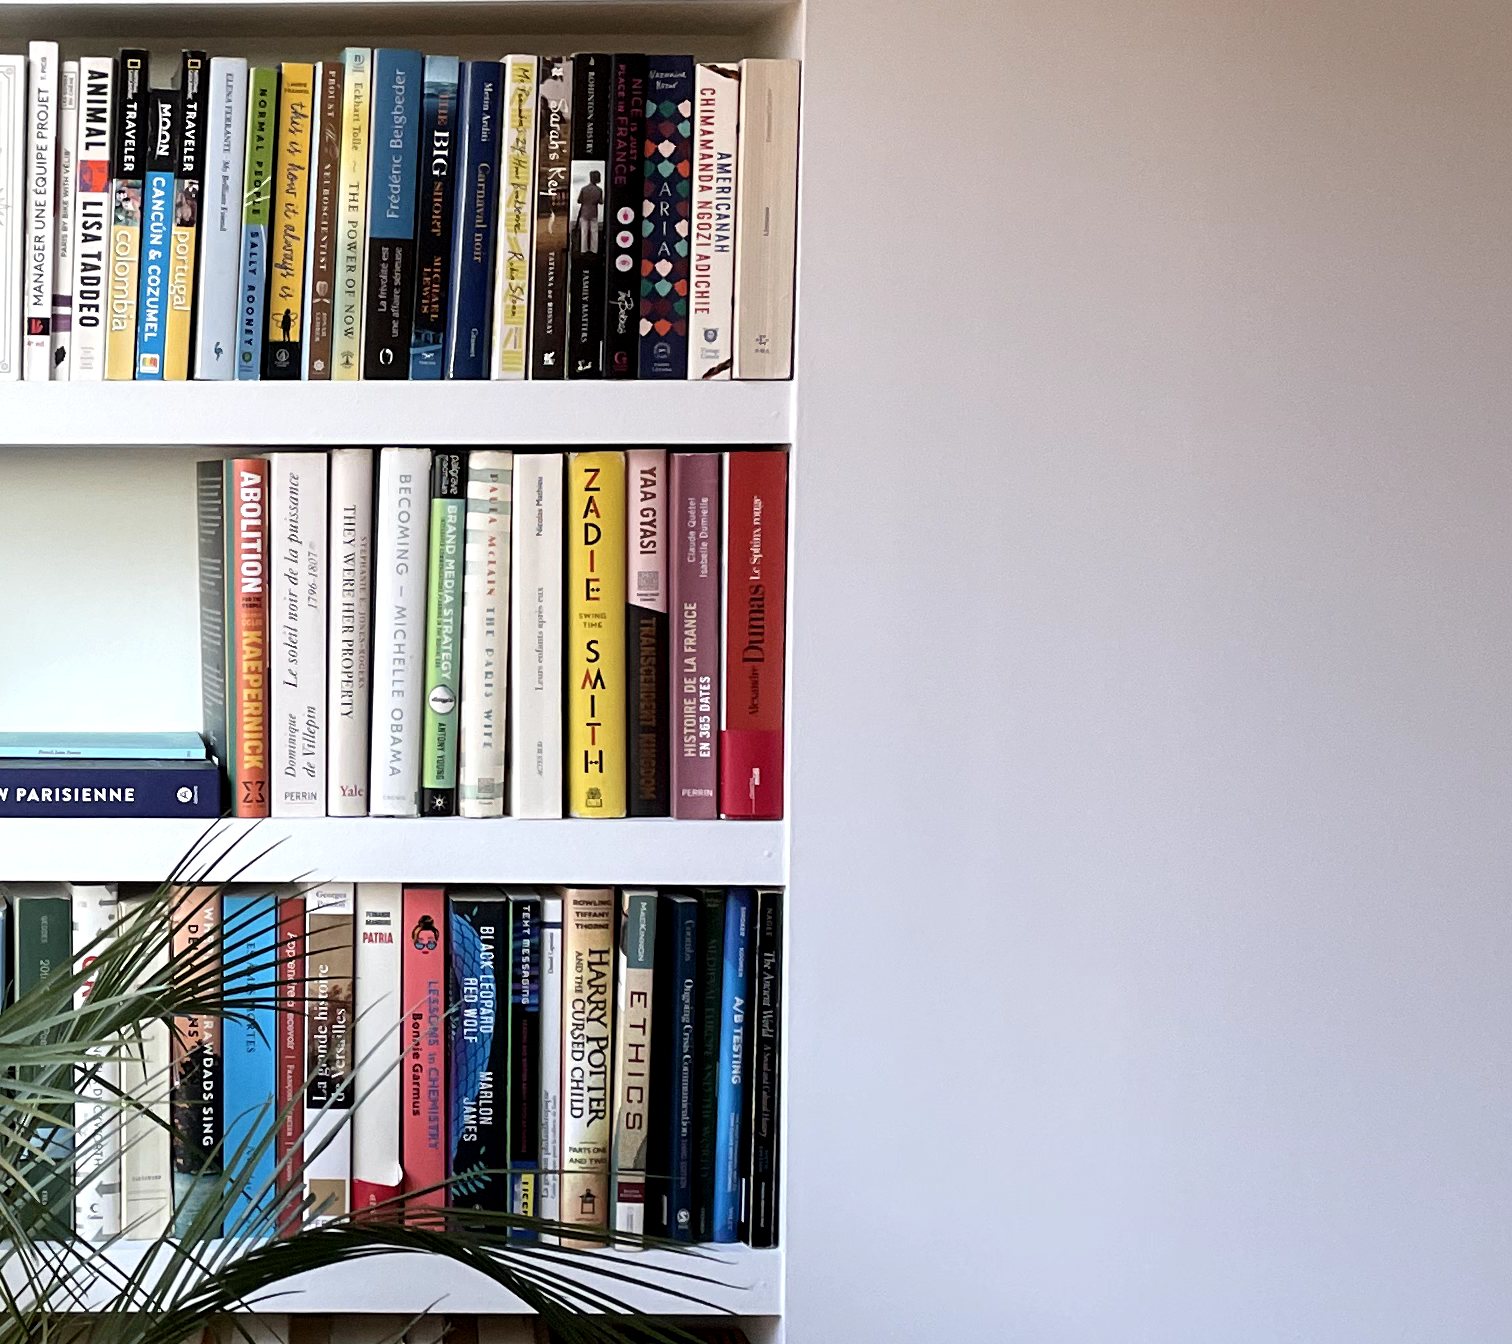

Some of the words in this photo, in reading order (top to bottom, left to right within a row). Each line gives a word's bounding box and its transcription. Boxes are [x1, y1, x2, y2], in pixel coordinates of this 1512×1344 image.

[36, 88, 49, 140] PROJET
[84, 68, 109, 150] ANIMAL
[352, 82, 364, 119] Eckhart
[388, 70, 406, 149] Beigbeder
[123, 102, 138, 172] TRAVELER
[157, 103, 172, 156] MOON
[183, 102, 198, 172] TRAVELER
[351, 122, 362, 150] Tolle
[431, 130, 450, 177] BIG
[548, 98, 565, 160] Sarah's
[697, 87, 716, 192] CHIMAMANDA
[32, 145, 48, 196] ÉQUIPE
[385, 156, 400, 218] Frédéric
[475, 162, 490, 228] Carnaval
[539, 167, 562, 196] Key
[33, 200, 46, 231] UNE
[82, 201, 103, 242] LISA
[150, 176, 170, 243] CANCÚN
[347, 181, 360, 213] THE
[715, 151, 733, 253] AMERICANAH
[345, 220, 359, 272] POWER
[473, 233, 486, 262] noir
[696, 200, 712, 247] NGOZI
[32, 235, 46, 306] MANAGER
[149, 248, 162, 260] &
[170, 231, 192, 310] portugal
[248, 231, 260, 275] SALLY
[78, 251, 102, 328] TADDEO
[111, 230, 133, 331] colombia
[144, 265, 161, 342] COZUMEL
[345, 278, 357, 298] OF
[694, 253, 711, 314] ADICHIE
[244, 284, 257, 346] ROONEY
[343, 304, 355, 338] NOW
[286, 472, 302, 545] puissance
[640, 466, 656, 502] YAA
[241, 471, 262, 592] ABOLITION
[343, 504, 356, 547] THEY
[396, 473, 412, 576] BECOMING
[445, 505, 457, 554] BRAND
[583, 468, 601, 601] ZADIE
[639, 507, 656, 555] GYASI
[285, 549, 299, 564] la
[285, 568, 299, 586] de
[342, 552, 355, 598] WERE
[444, 558, 455, 604] MEDIA
[284, 589, 299, 621] noir
[341, 602, 354, 634] HER
[684, 602, 697, 654] FRANCE
[742, 585, 765, 663] Dumas
[283, 627, 299, 664] soleil
[391, 605, 406, 698] MICHELLE
[441, 608, 454, 679] STRATEGY
[683, 656, 697, 672] LA
[243, 630, 264, 769] KAEPERNICK
[283, 668, 299, 688] Le
[340, 639, 354, 719] PROPERTY
[683, 676, 697, 694] DE
[699, 676, 711, 712] DATES
[581, 639, 606, 773] SMITH
[683, 696, 697, 757] HISTOIRE
[699, 715, 711, 739] 365
[388, 708, 405, 777] OBAMA
[699, 742, 711, 758] EN
[16, 787, 135, 802] PARISIENNE
[480, 926, 494, 968] BLACK
[428, 980, 440, 1046] LESSONS
[463, 977, 478, 1003] RED
[479, 974, 494, 1033] LEOPARD
[588, 948, 610, 1031] HARRY
[732, 996, 744, 1022] A/B
[411, 1012, 423, 1059] Bonnie
[463, 1008, 477, 1043] WOLF
[569, 998, 585, 1061] CURSED
[586, 1035, 608, 1128] POTTER
[626, 990, 648, 1131] ETHICS
[731, 1027, 743, 1084] TESTING
[411, 1063, 423, 1116] Garmus
[428, 1067, 439, 1149] CHEMISTRY
[479, 1071, 493, 1124] MARLON
[570, 1066, 584, 1118] CHILD
[462, 1097, 477, 1141] JAMES
